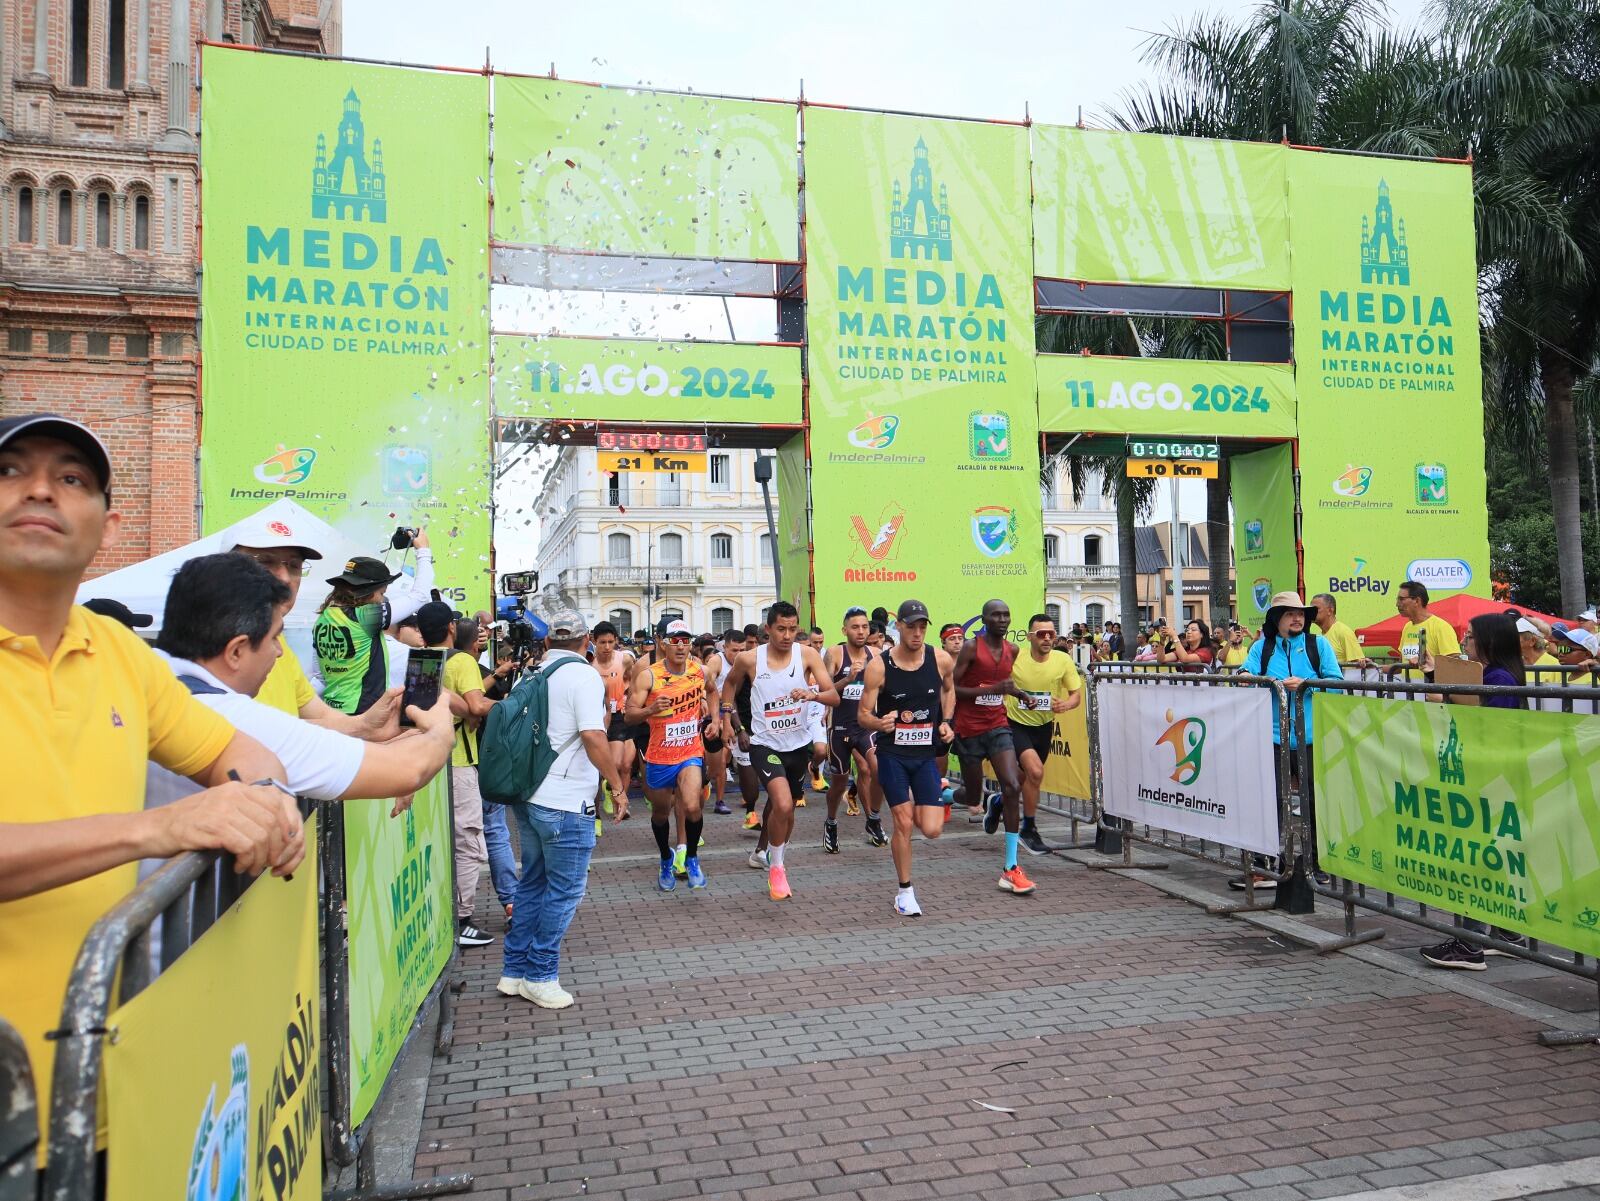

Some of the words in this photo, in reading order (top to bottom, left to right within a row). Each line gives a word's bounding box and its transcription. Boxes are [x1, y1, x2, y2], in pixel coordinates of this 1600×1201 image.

[246, 225, 448, 276] MEDIA
[246, 275, 449, 312] MARATÓN
[837, 265, 1005, 309] MEDIA
[1319, 290, 1452, 327] MEDIA
[245, 311, 449, 337] INTERNACIONAL
[838, 311, 1006, 342] MARATÓN
[245, 334, 324, 351] CIUDAD
[333, 335, 358, 353] DE
[367, 339, 448, 356] PALMIRA
[1321, 329, 1453, 356] MARATÓN
[838, 345, 1007, 365] INTERNACIONAL
[839, 365, 903, 380] CIUDAD
[911, 367, 931, 381] DE
[939, 369, 1006, 384] PALMIRA
[1322, 358, 1454, 376] INTERNACIONAL
[524, 361, 775, 399] 11.AGO.2024
[1323, 376, 1374, 389] CIUDAD
[1379, 378, 1396, 390] DE
[1401, 379, 1455, 392] PALMIRA
[1064, 380, 1270, 413] 11.AGO.2024
[828, 451, 926, 464] ImderPalmira
[1133, 443, 1218, 458] 0:0002
[617, 458, 641, 469] 21
[653, 458, 689, 470] Km
[1144, 464, 1167, 475] 10
[1173, 464, 1203, 475] Km
[229, 487, 347, 500] ImderPalmira
[1318, 498, 1394, 509] ImderPalmira
[844, 567, 917, 582] Atletismo
[1414, 566, 1463, 577] AISLATER
[1329, 576, 1390, 595] BetPlay
[667, 724, 695, 737] 21801
[771, 717, 797, 729] 0004
[897, 731, 930, 741] 21599
[1138, 783, 1226, 815] ImderPalmira
[1395, 781, 1522, 842] MEDIA
[1396, 824, 1526, 878] MARATÓN
[391, 844, 432, 930] MEDIA
[1394, 854, 1528, 904] INTERNACIONAL
[1396, 874, 1444, 898] CIUDAD
[1448, 888, 1465, 903] DE
[1469, 892, 1528, 924] PALMIRA
[396, 894, 433, 976] MARATÓN
